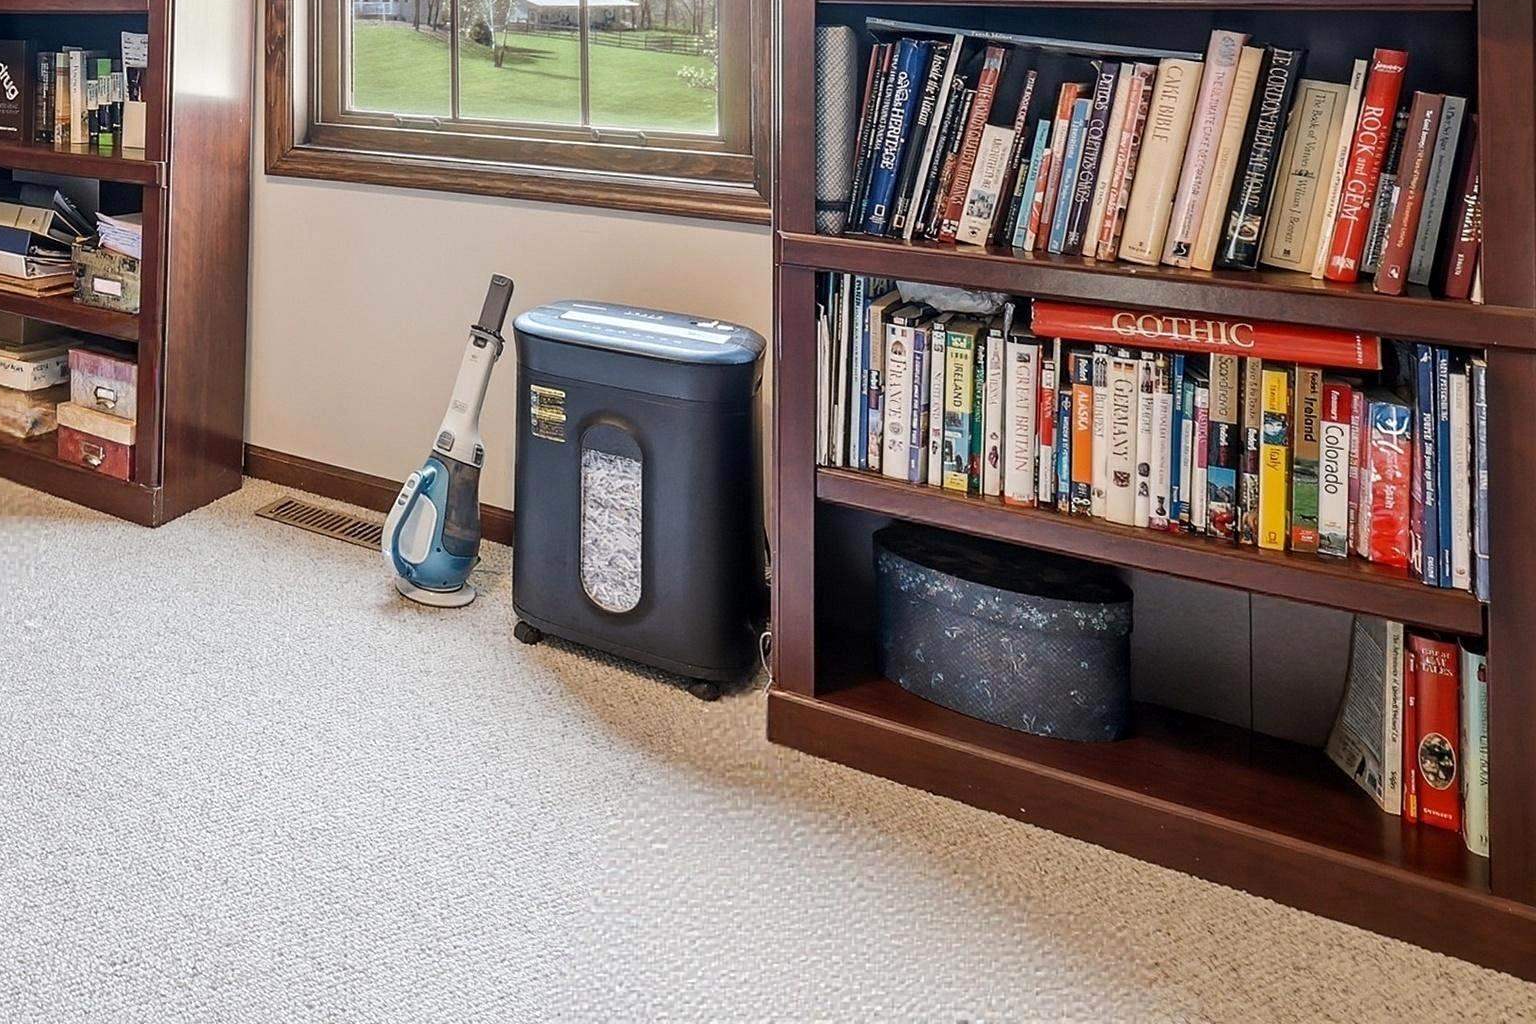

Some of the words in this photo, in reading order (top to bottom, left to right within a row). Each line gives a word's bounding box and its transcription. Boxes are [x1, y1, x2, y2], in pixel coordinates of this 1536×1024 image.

[932, 54, 946, 78] Inside
[1272, 47, 1293, 65] LE
[1161, 65, 1184, 104] CAKE
[1261, 66, 1288, 119] CORDON
[1315, 94, 1327, 109] The
[880, 107, 905, 170] HERITAGE
[1152, 106, 1174, 143] BIBLE
[1252, 121, 1275, 155] BLEU
[1307, 130, 1317, 141] of
[1310, 108, 1324, 131] Book
[1354, 105, 1385, 157] ROCK
[1355, 158, 1369, 176] and
[1340, 178, 1367, 222] GEM
[1112, 312, 1255, 347] GOTHIC
[889, 360, 904, 418] FRANCE
[953, 364, 962, 407] IRELAND
[1017, 365, 1029, 410] GREAT
[1217, 357, 1232, 417] Scandinavia
[1077, 391, 1087, 431] ALASKA
[1112, 379, 1130, 462] GERMANY
[1140, 397, 1153, 434] PRAGUE
[1303, 398, 1316, 442] Ireland
[1015, 416, 1029, 472] BRITAIN
[1268, 448, 1281, 471] Italy
[1325, 425, 1342, 495] Colorado
[1385, 485, 1395, 509] Spain
